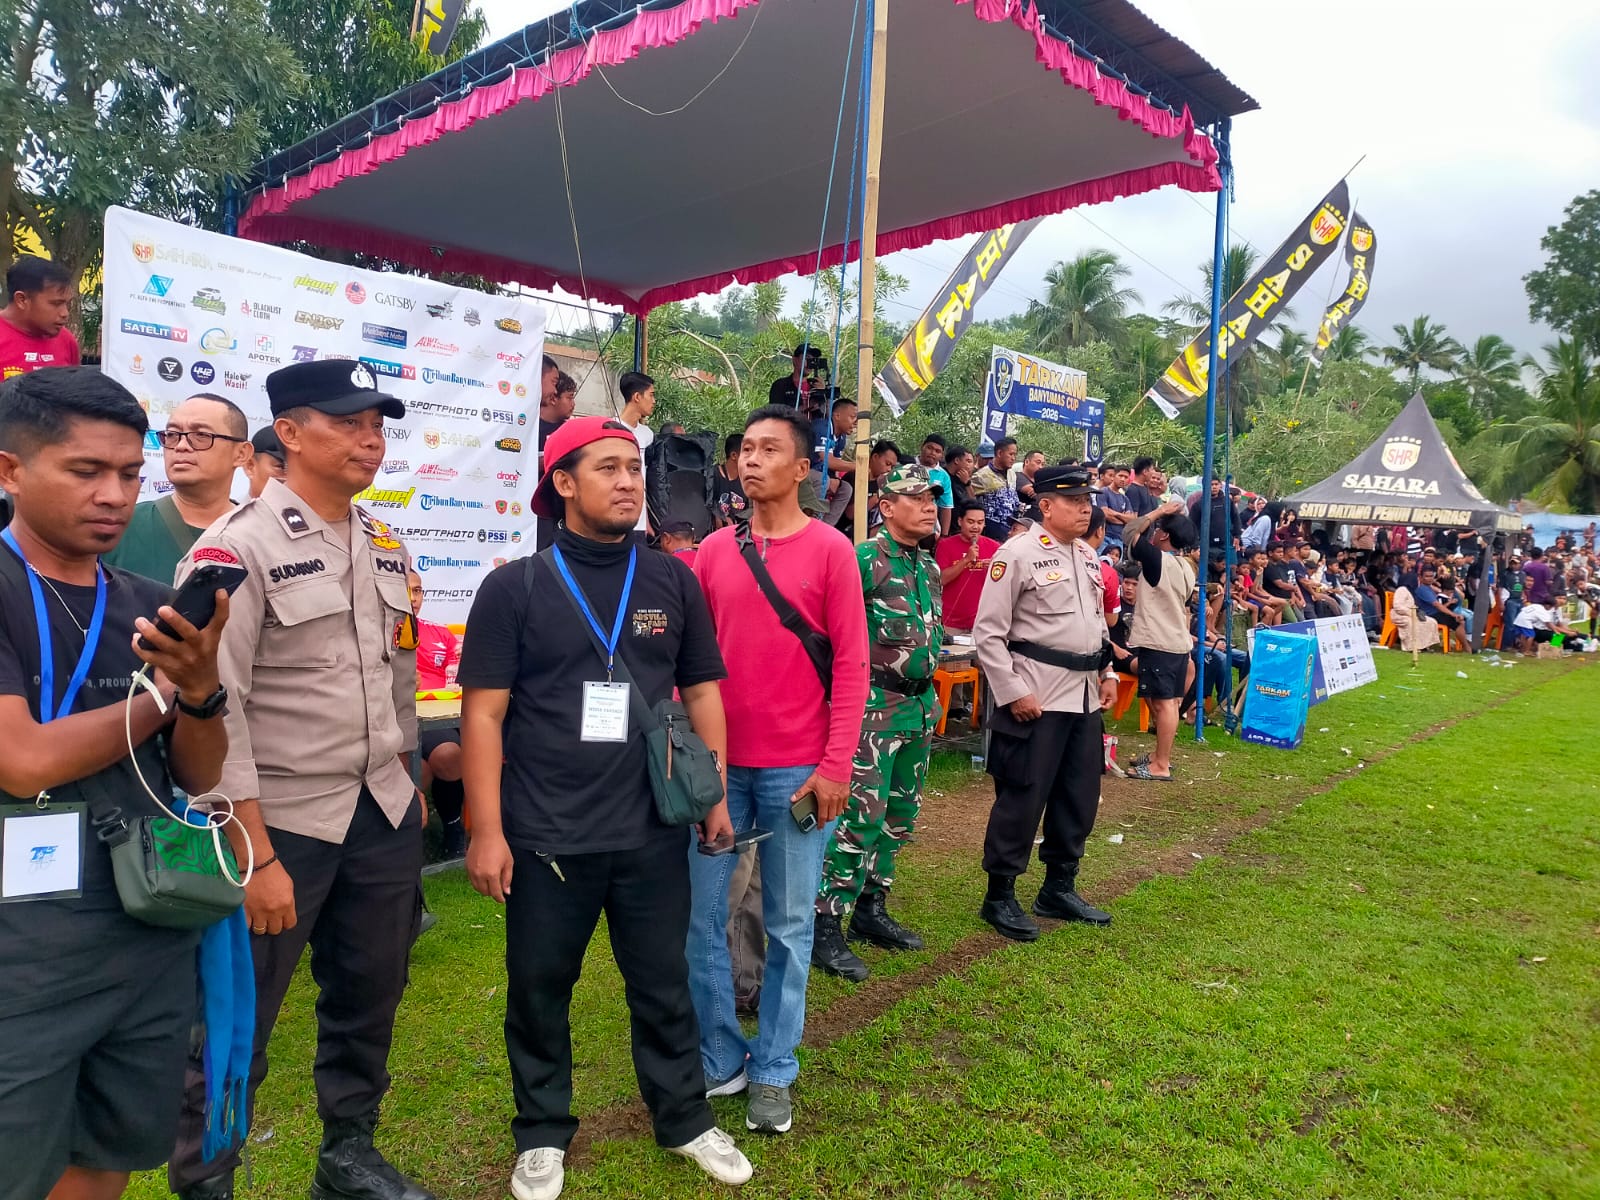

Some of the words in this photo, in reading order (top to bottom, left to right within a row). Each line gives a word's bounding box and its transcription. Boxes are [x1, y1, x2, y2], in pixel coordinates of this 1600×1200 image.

[1314, 215, 1336, 239] SHR
[374, 291, 417, 312] GATSBY
[124, 322, 170, 337] SATELIT
[172, 329, 187, 341] TV
[248, 352, 281, 364] APOTEK
[496, 351, 521, 363] drone
[193, 366, 213, 377] 442
[402, 367, 415, 377] TV
[1018, 355, 1088, 402] TARKAM
[1028, 387, 1065, 407] BANYUMAS
[1066, 397, 1079, 412] CUP
[493, 410, 514, 422] PSSI
[1387, 448, 1413, 465] SHR
[497, 471, 519, 481] drone
[1341, 474, 1441, 496] SAHARA
[370, 501, 402, 509] SHOES
[1298, 502, 1327, 518] SATU
[487, 531, 508, 541] PSSI
[1032, 559, 1060, 570] TARTO
